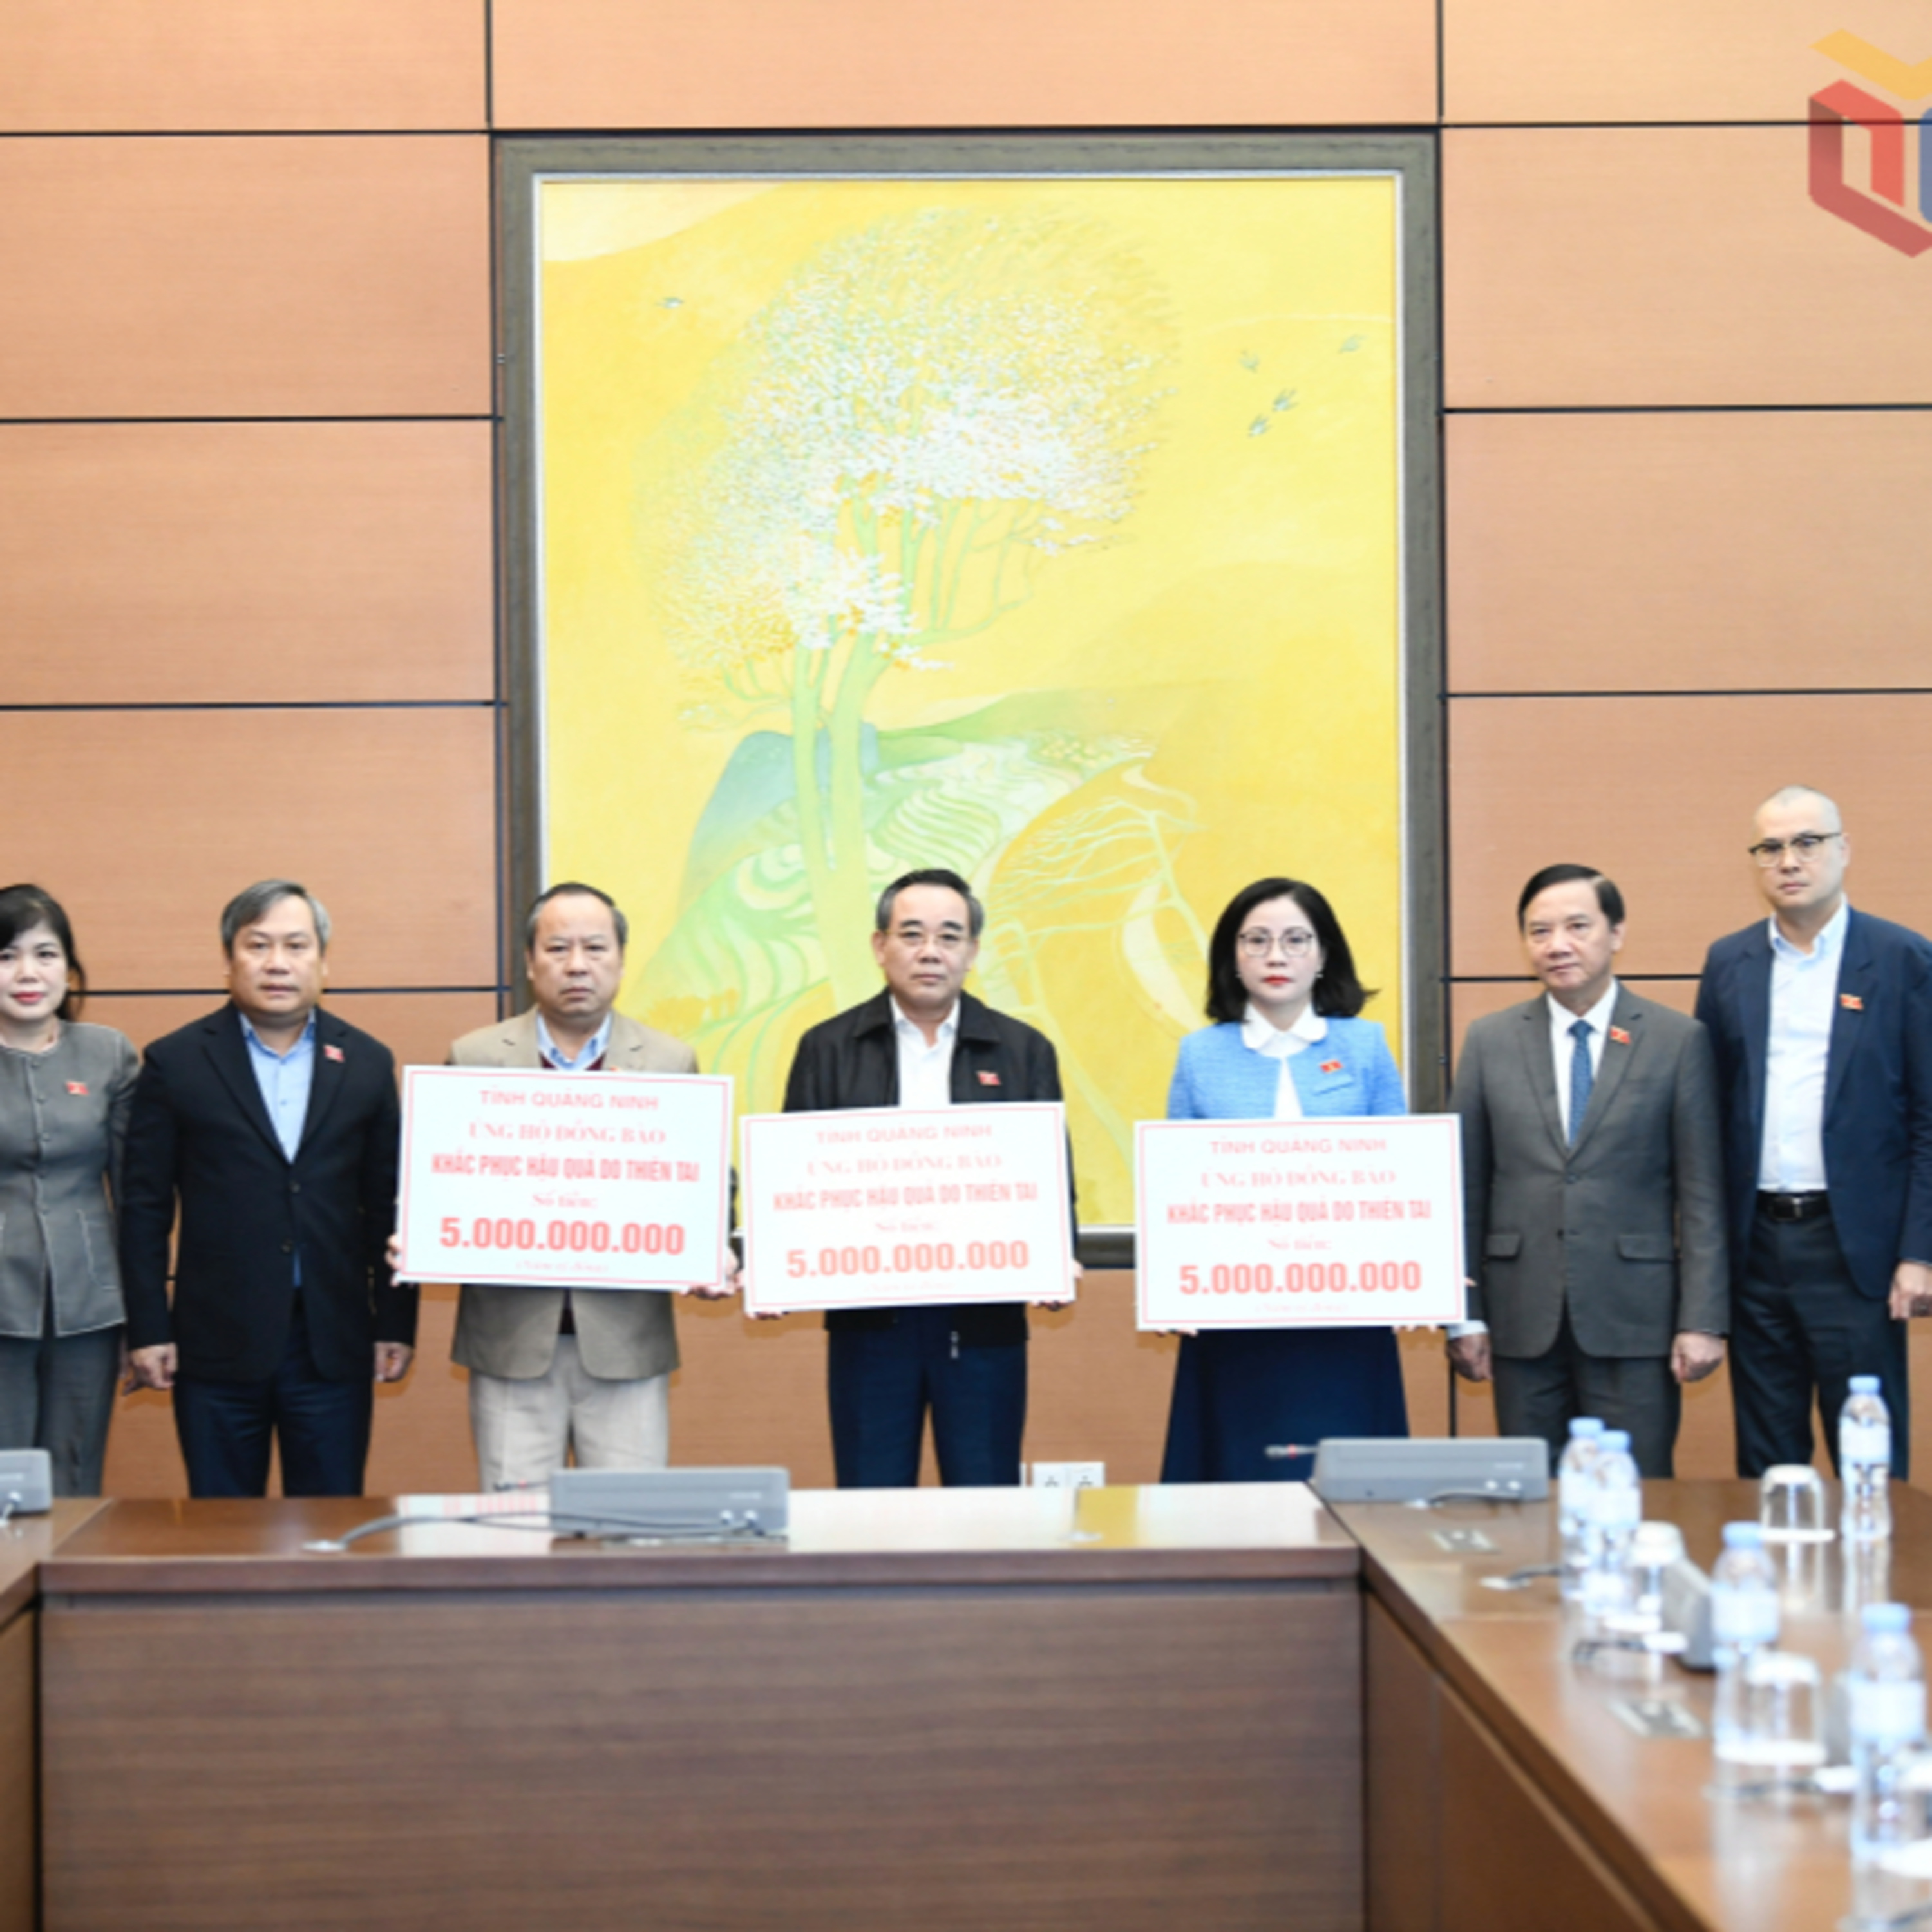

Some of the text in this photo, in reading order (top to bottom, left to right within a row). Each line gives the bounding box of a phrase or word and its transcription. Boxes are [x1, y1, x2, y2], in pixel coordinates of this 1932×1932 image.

[609, 1095, 659, 1111] NINH
[943, 1124, 992, 1139] NINH
[1338, 1139, 1387, 1151] NINH
[430, 1146, 700, 1182] KHẮC PHỤC HẬU QUẢ DO THIÊN TAI
[772, 1179, 1038, 1212] KHẮC PHỤC HẬU QUẢ DO THIÊN TAI
[1166, 1195, 1432, 1227] KHẮC PHỤC HẬU QUẢ DO THIÊN TAI
[439, 1215, 686, 1256] 5.000.000.000
[786, 1240, 1030, 1278] 5.000.000.000
[1178, 1260, 1423, 1295] 5.000.000.000
